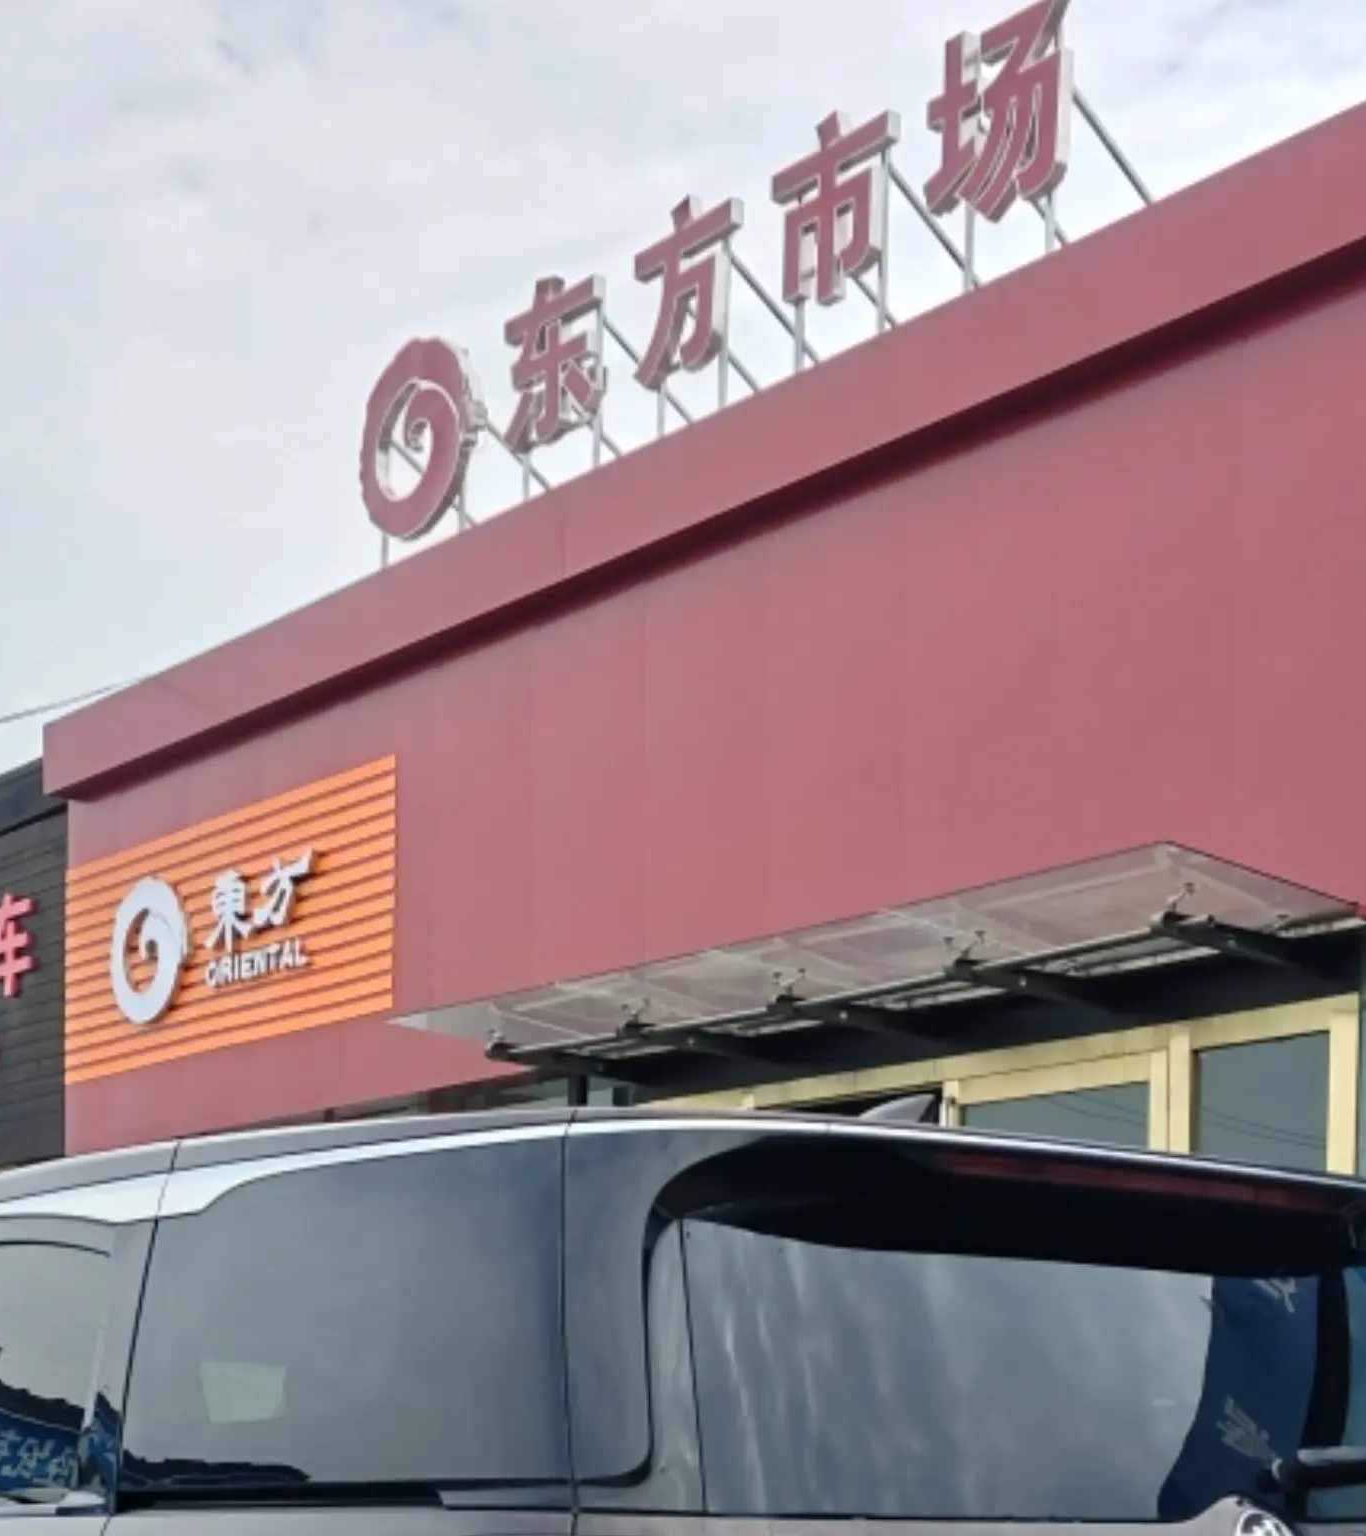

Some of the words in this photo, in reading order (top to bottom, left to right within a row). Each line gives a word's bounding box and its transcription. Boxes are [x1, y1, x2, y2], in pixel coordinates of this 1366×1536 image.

[504, 0, 1073, 452] 东方市场
[206, 937, 308, 988] ORIENTAL
